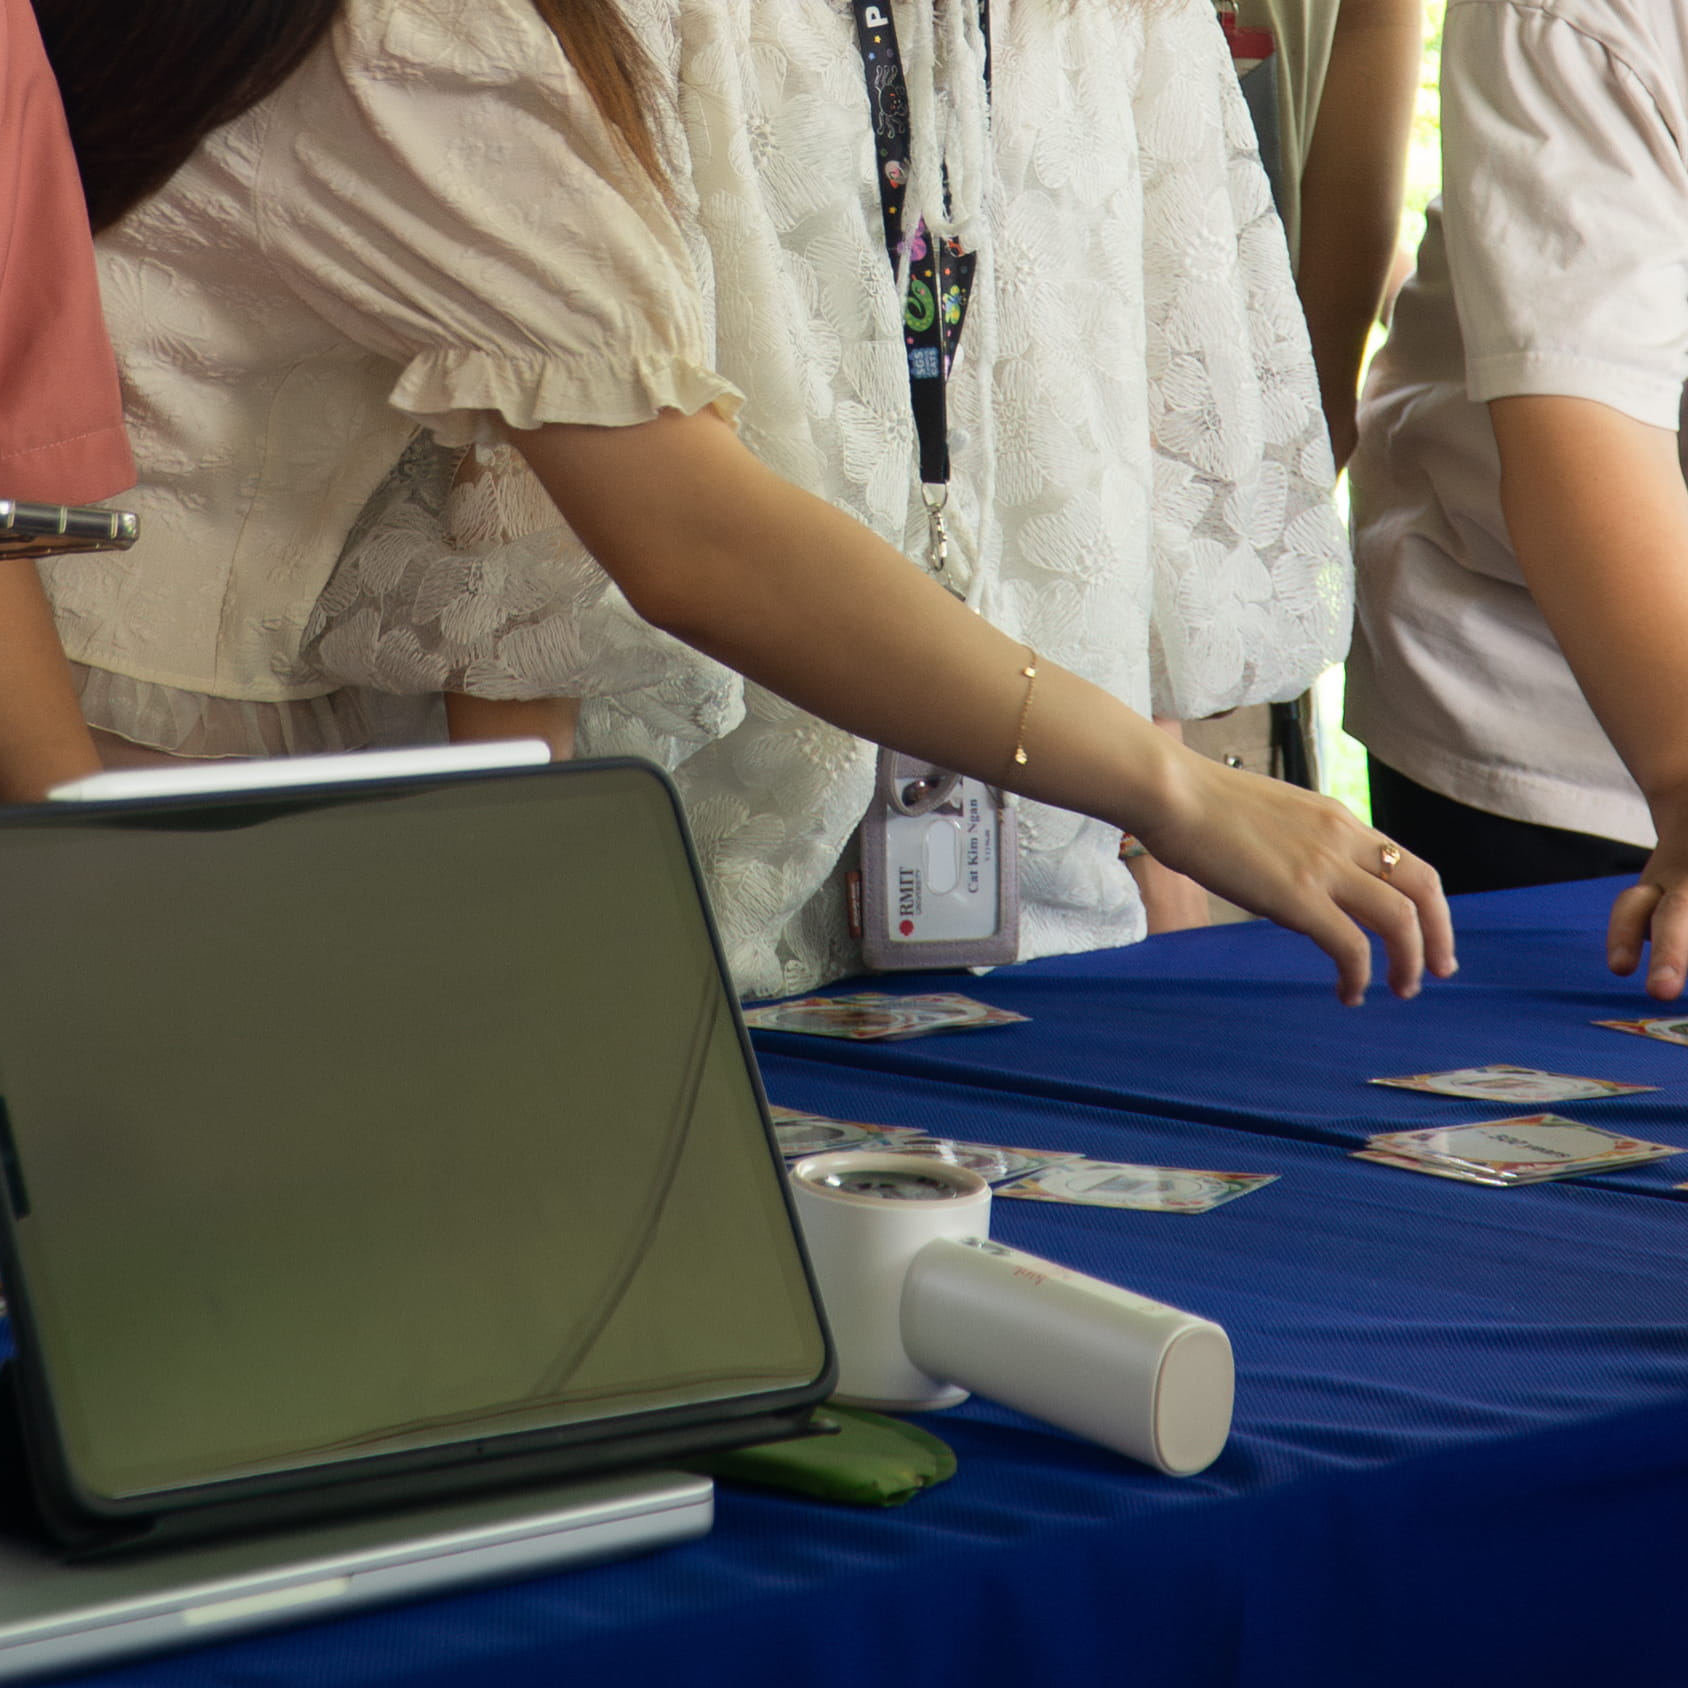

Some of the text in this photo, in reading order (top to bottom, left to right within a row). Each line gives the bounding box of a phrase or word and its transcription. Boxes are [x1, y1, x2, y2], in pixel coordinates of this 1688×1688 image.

[968, 799, 981, 893] Cat Kim Ngan
[899, 866, 914, 916] RMIT
